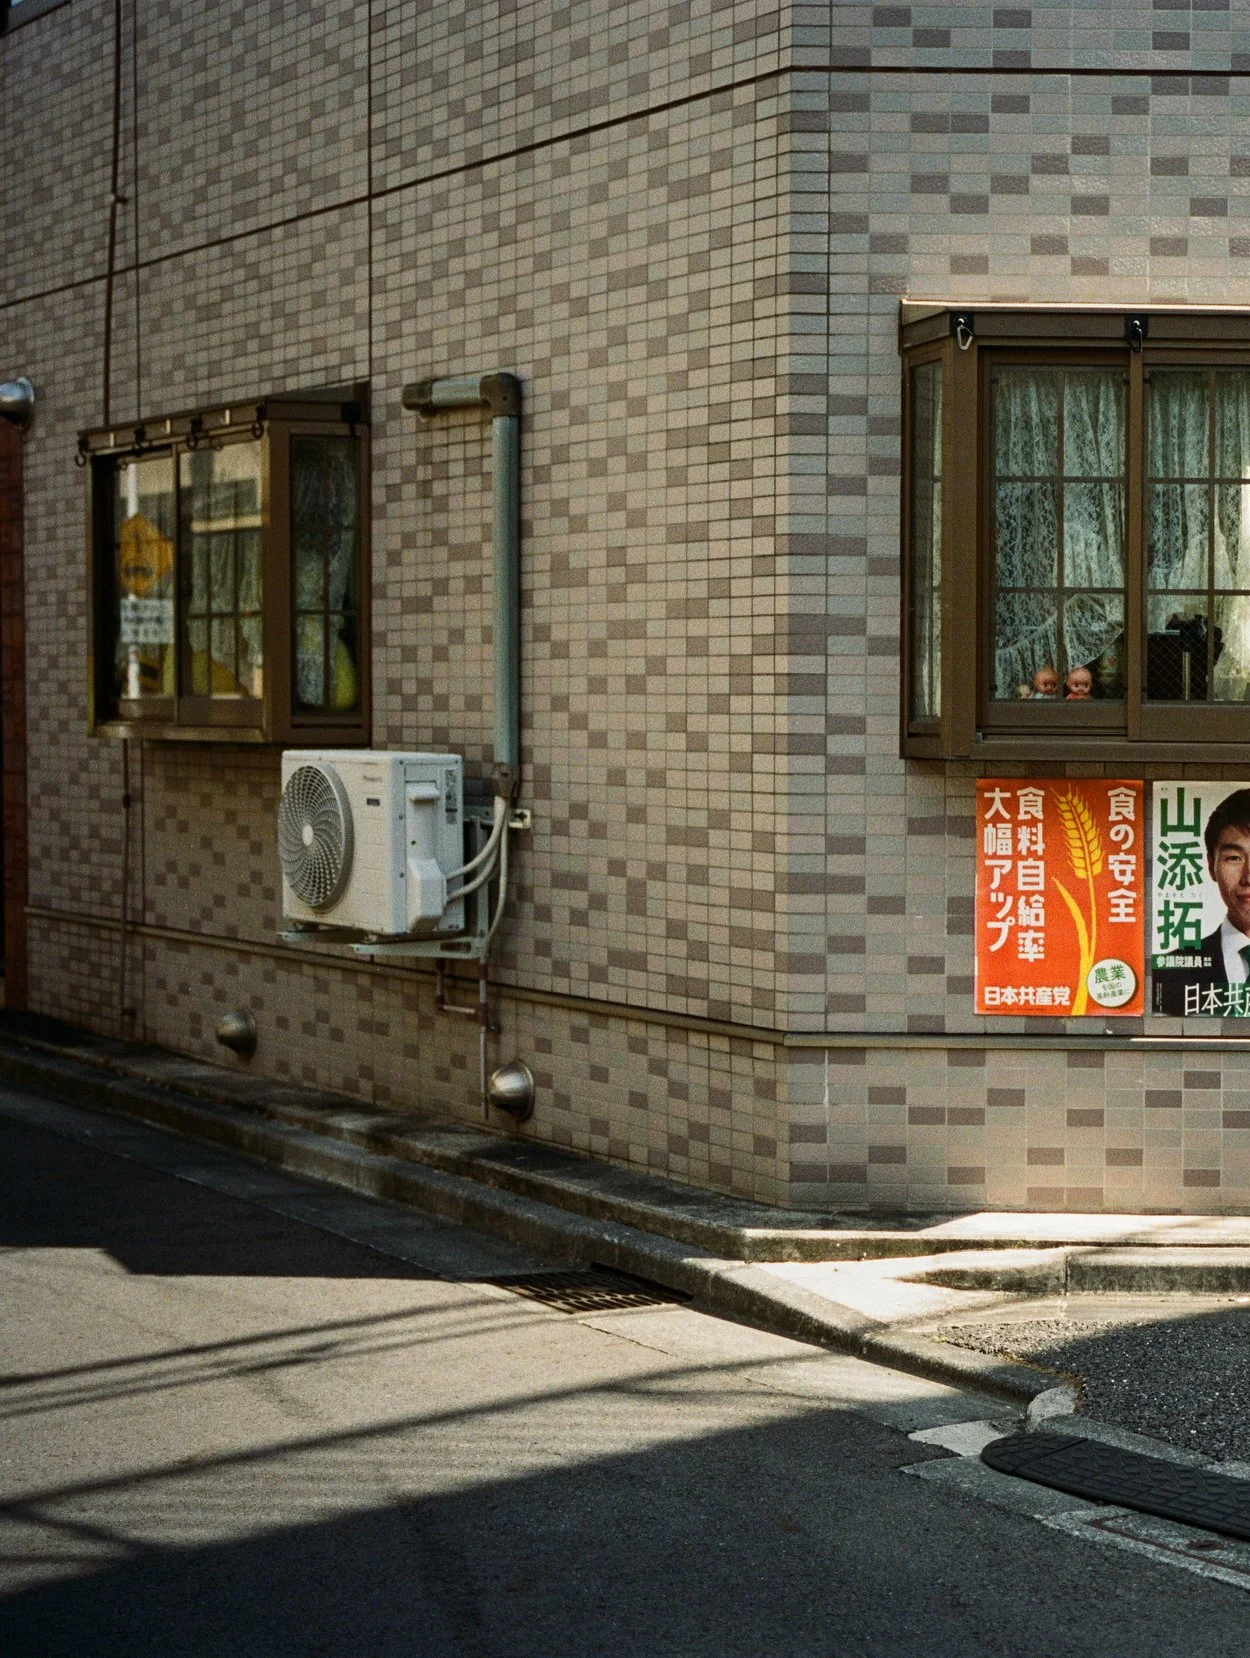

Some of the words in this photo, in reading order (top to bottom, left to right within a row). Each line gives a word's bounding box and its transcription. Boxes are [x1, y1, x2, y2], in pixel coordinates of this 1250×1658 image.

[983, 787, 1016, 952] 大幅アップ
[1017, 786, 1045, 962] 食料自給率
[1107, 786, 1137, 923] 食の安全
[1157, 787, 1203, 950] 山添拓
[984, 986, 1071, 1006] 日本共産党
[1095, 965, 1126, 984] 農業
